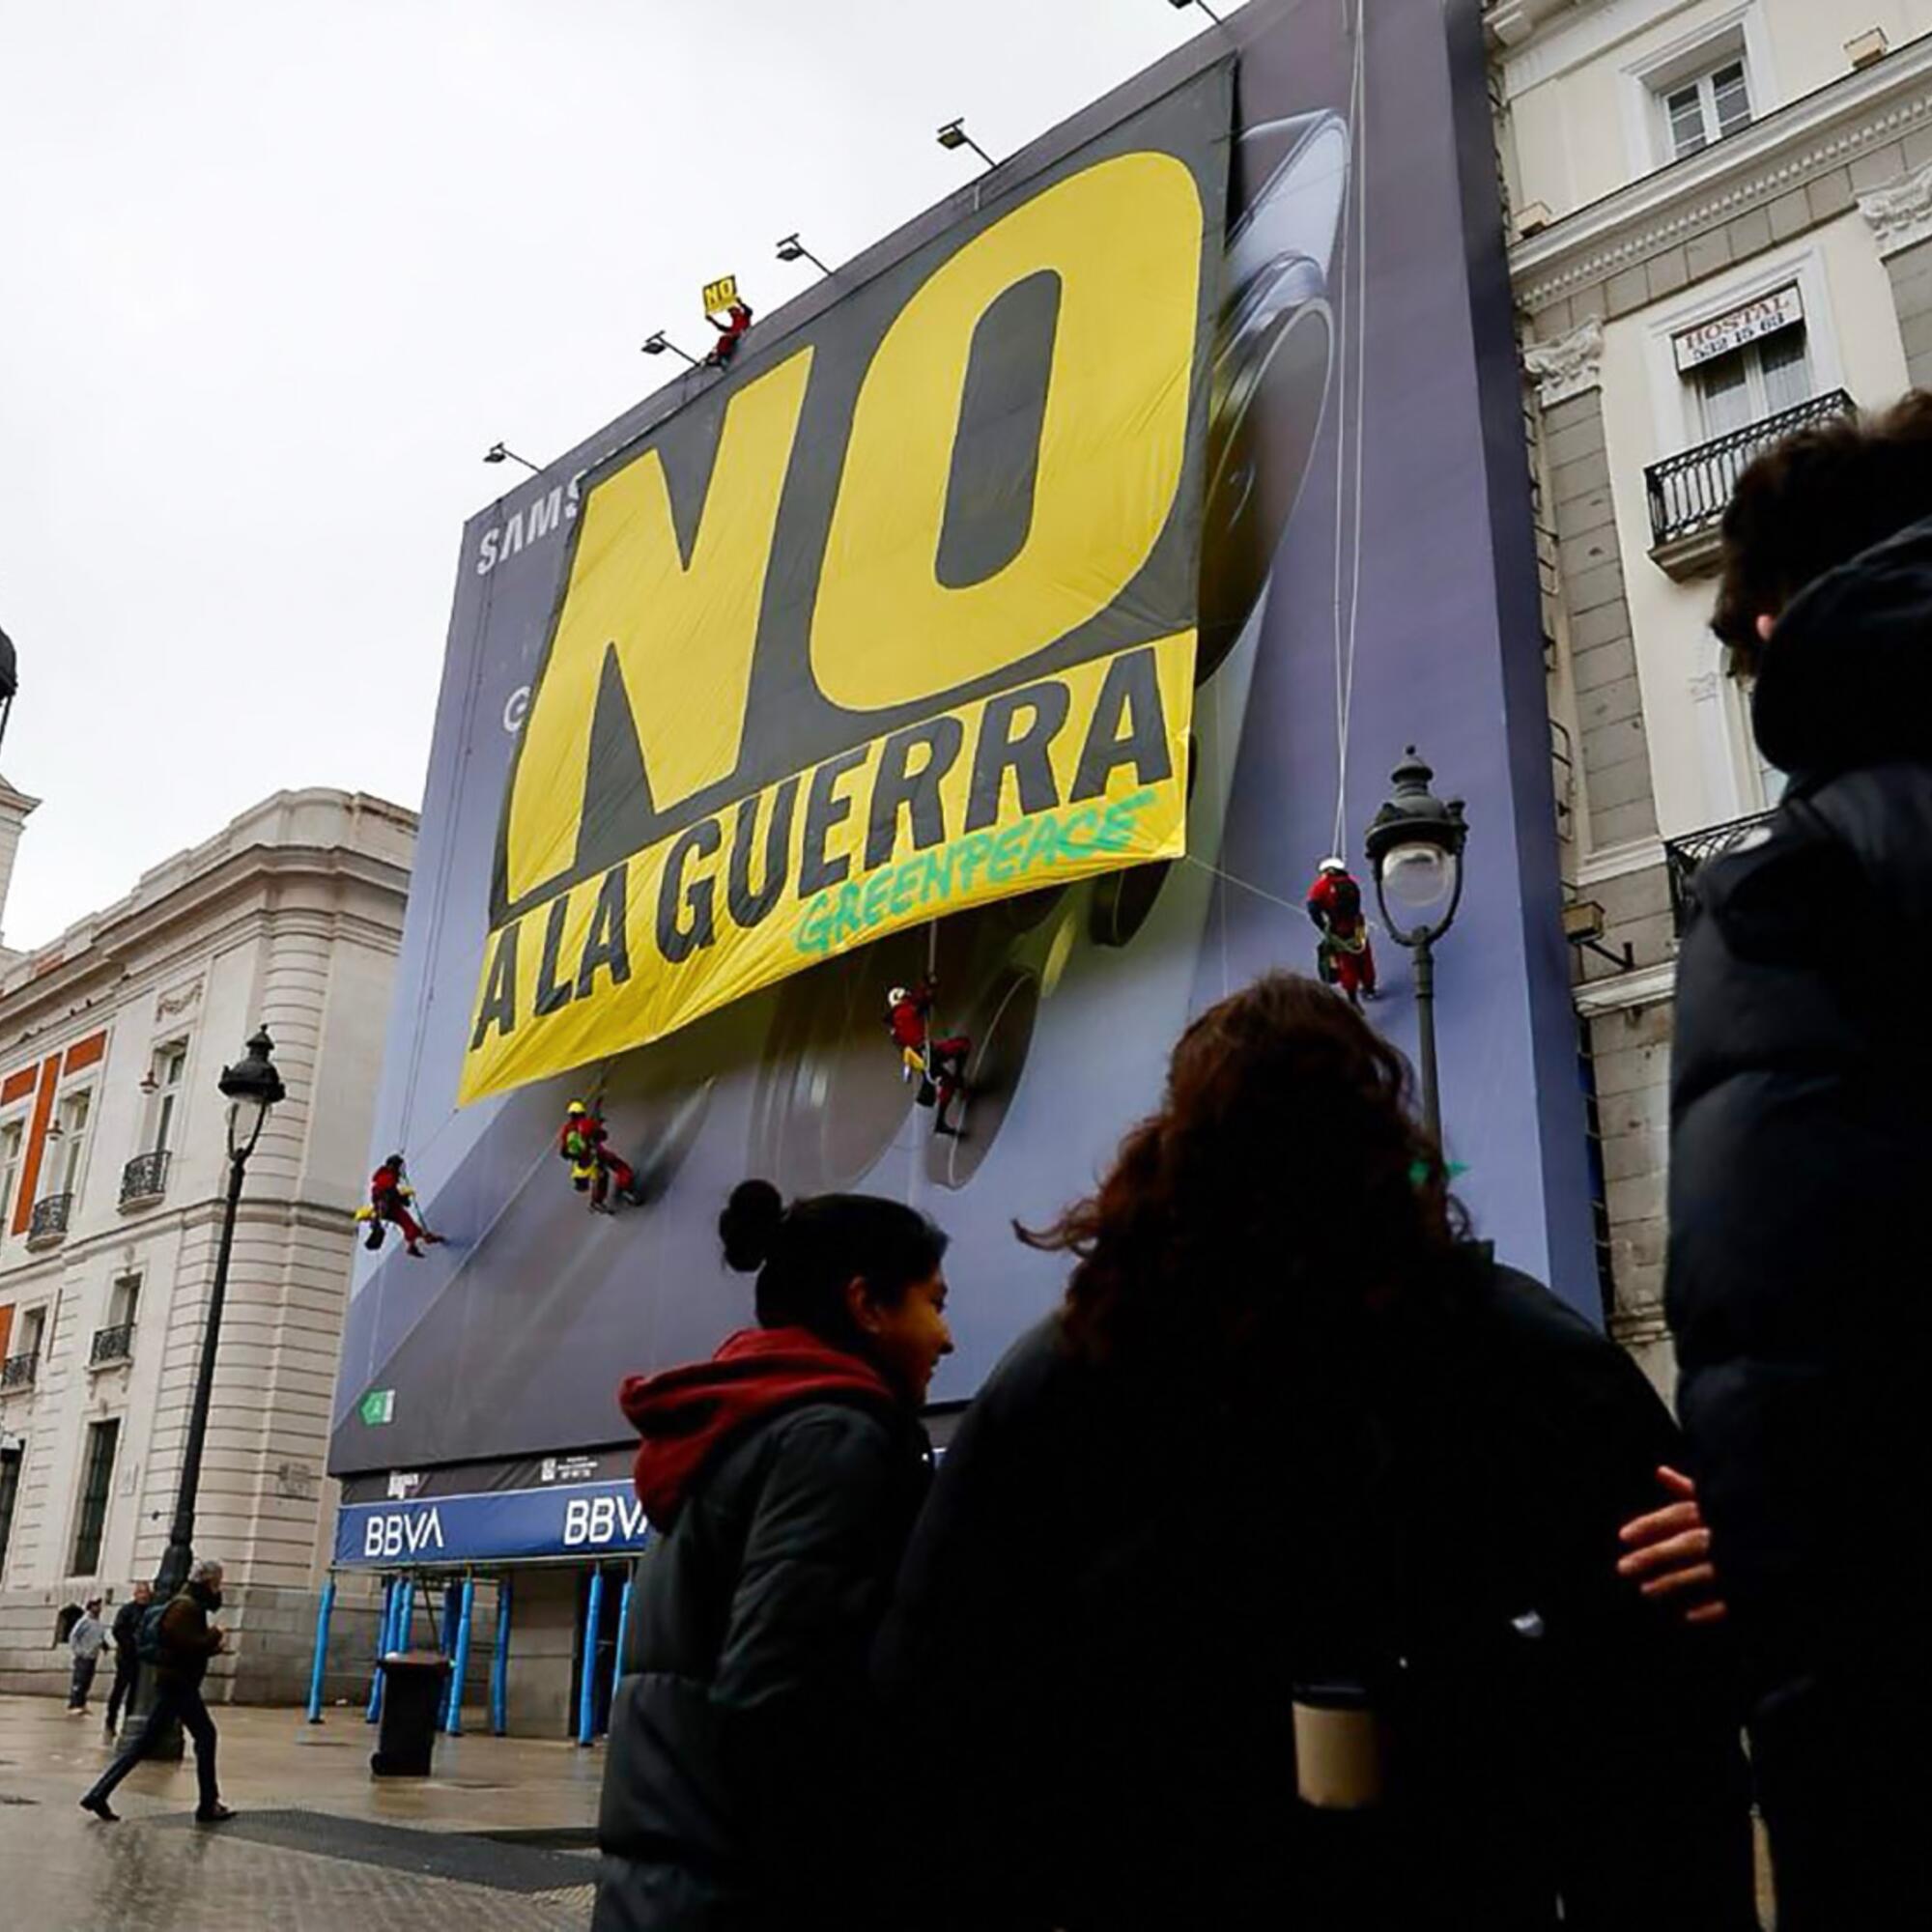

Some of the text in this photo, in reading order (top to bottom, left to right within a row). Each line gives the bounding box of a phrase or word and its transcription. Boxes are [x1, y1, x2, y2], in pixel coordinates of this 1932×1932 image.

[705, 278, 734, 308] NO
[1685, 297, 1790, 350] HOSTAL
[507, 151, 1204, 905] NO
[469, 647, 1173, 1051] A LA GUERRA
[790, 788, 1156, 954] GREENPEACE
[365, 1506, 444, 1556] BBVA
[564, 1495, 648, 1546] BBV
